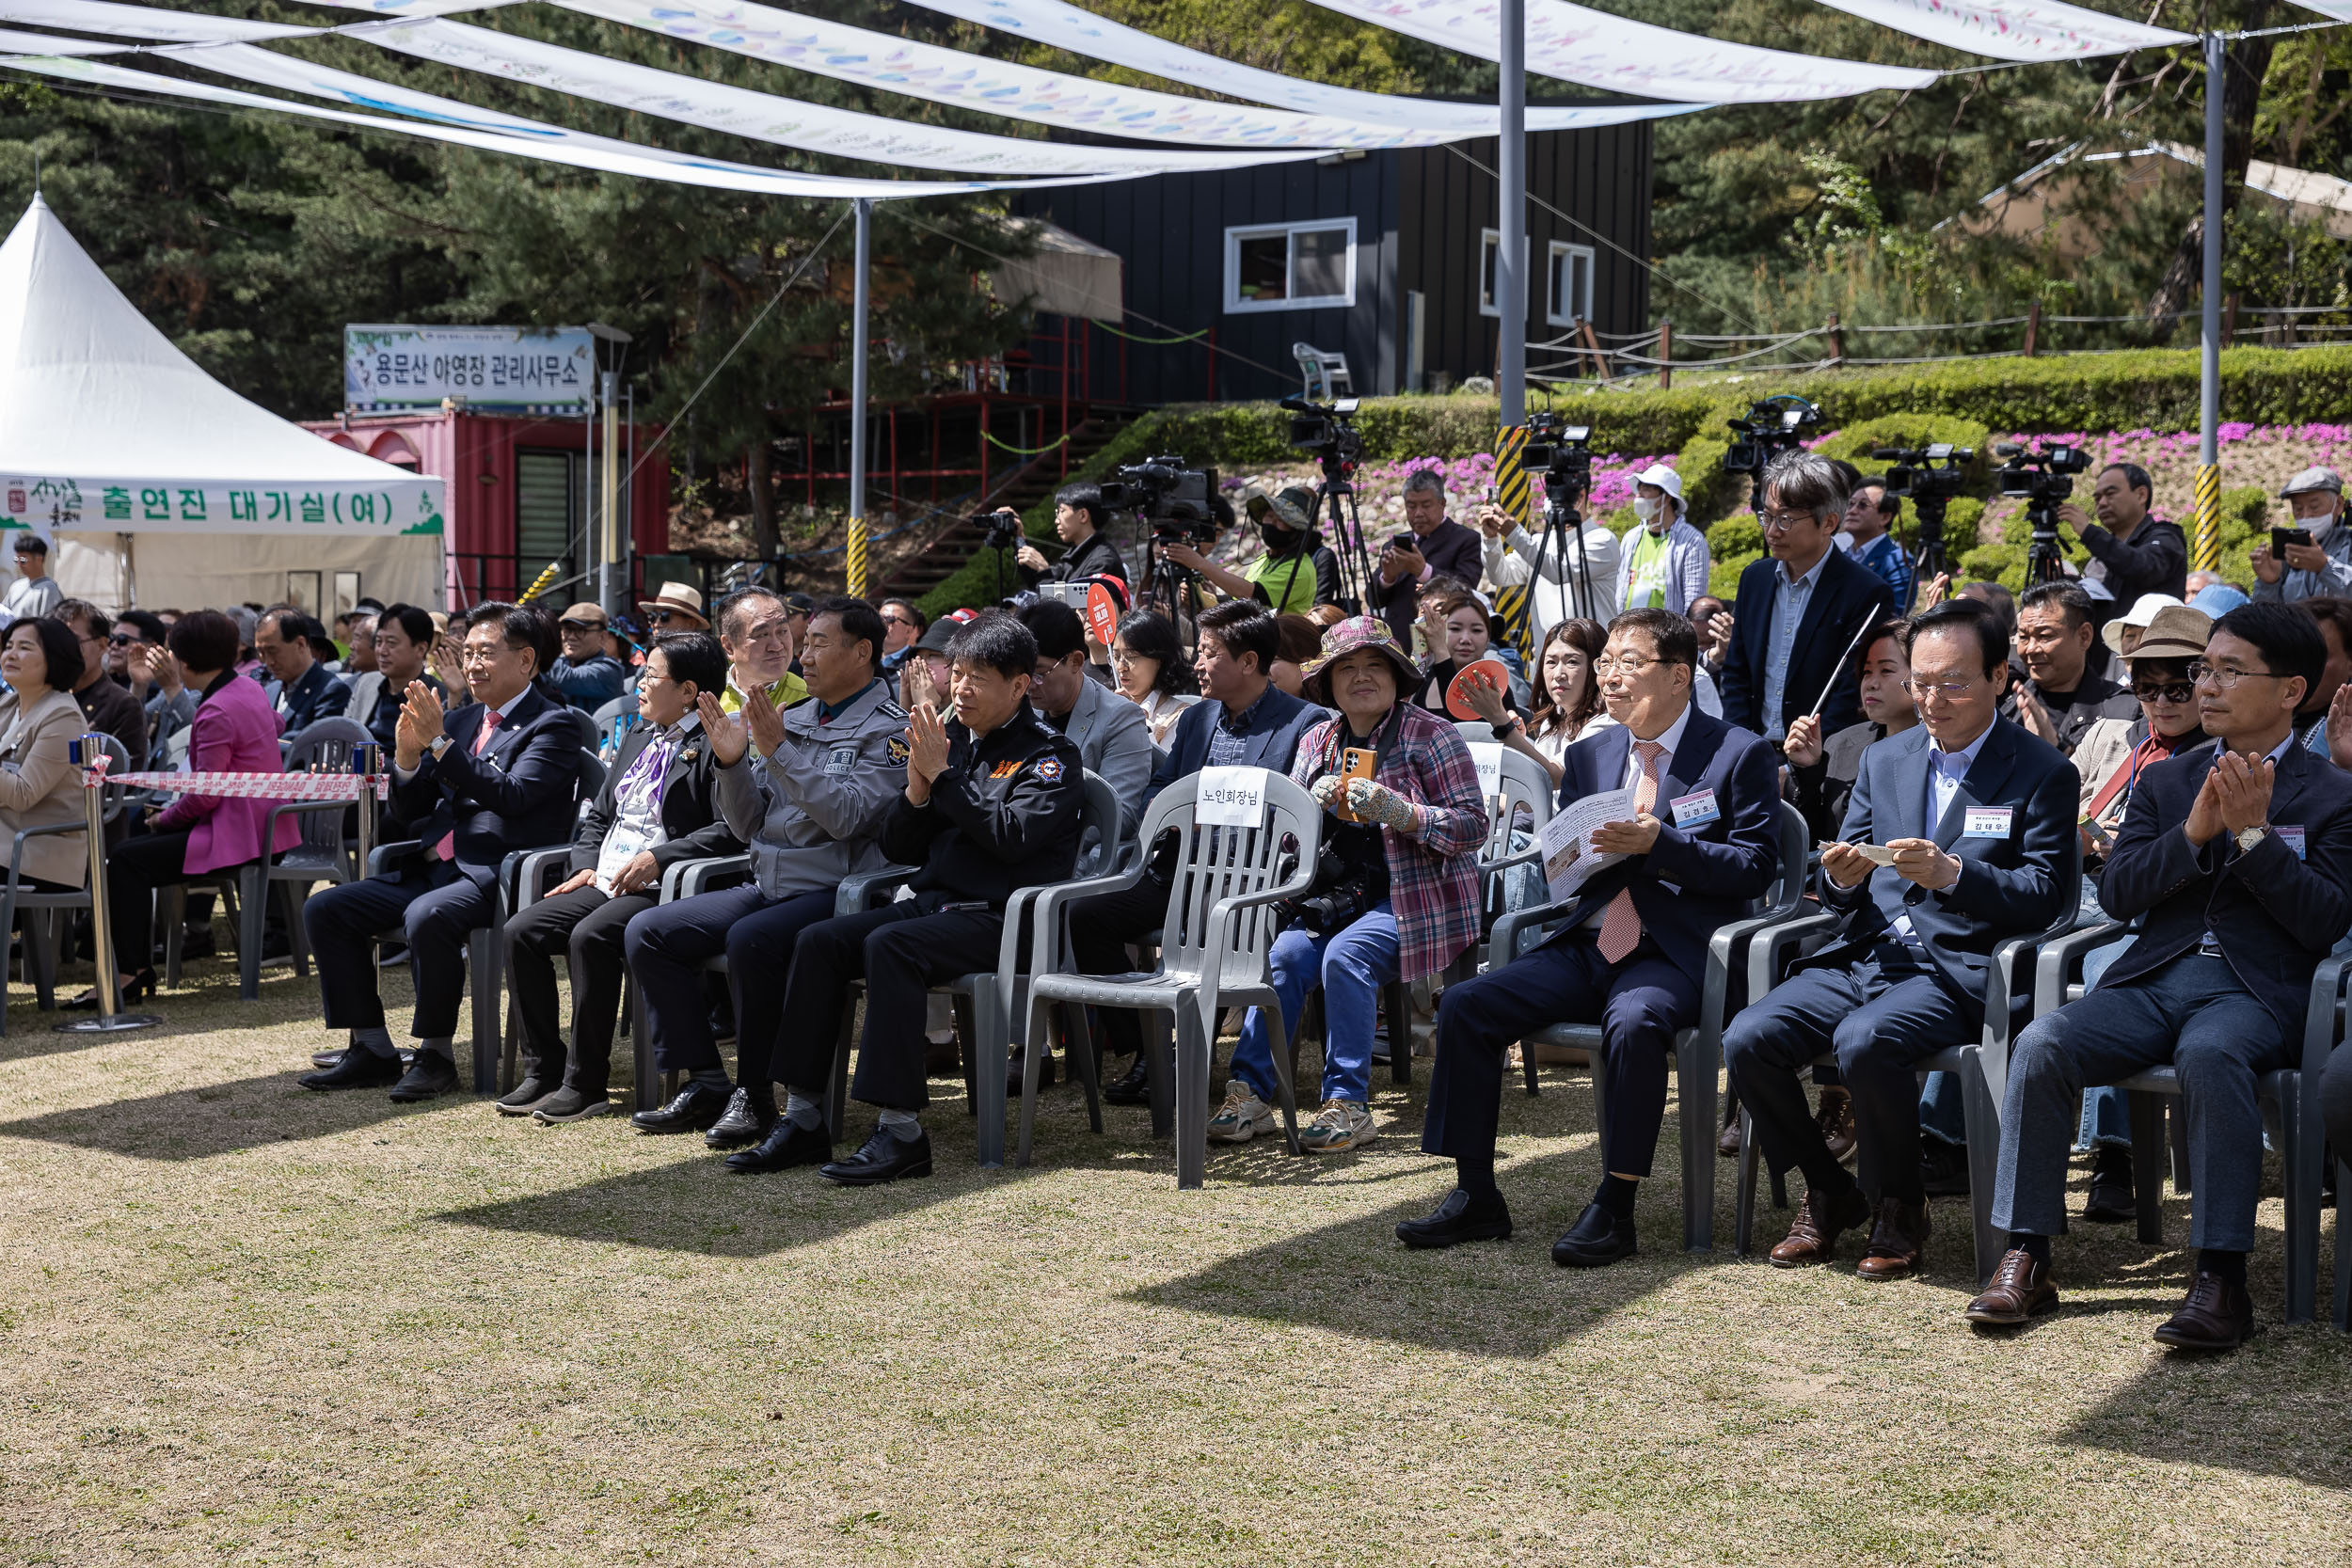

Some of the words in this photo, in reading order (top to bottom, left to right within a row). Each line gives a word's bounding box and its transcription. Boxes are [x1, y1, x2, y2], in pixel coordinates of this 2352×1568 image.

[375, 353, 429, 385] 용문산
[434, 354, 485, 387] 야영장
[491, 355, 579, 388] 관리사무소
[103, 486, 207, 521] 출연진
[230, 490, 393, 525] 대기실(여)
[1324, 733, 1338, 762] Canon
[1202, 788, 1258, 806] 노인회장님
[1683, 805, 1710, 818] 김경호
